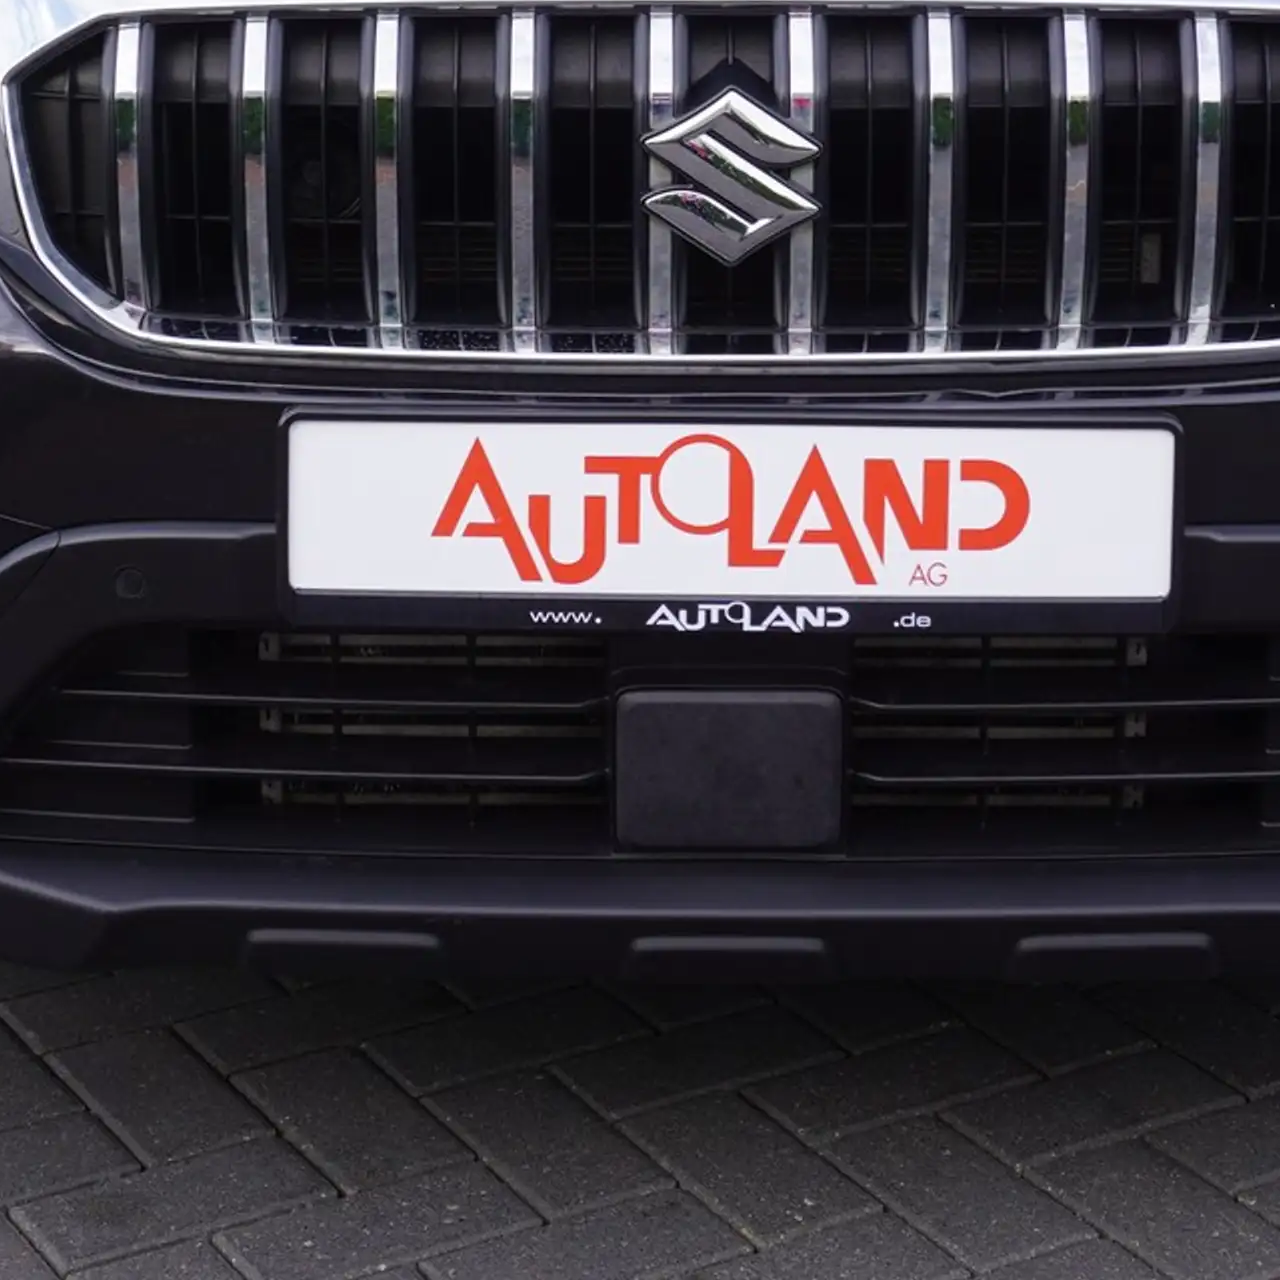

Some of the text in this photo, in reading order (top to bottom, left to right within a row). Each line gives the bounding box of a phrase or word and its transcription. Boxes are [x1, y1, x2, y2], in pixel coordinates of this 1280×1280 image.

[432, 433, 1030, 585] AUTOLAND
[908, 562, 949, 587] AG
[645, 600, 851, 633] AUTOLAND
